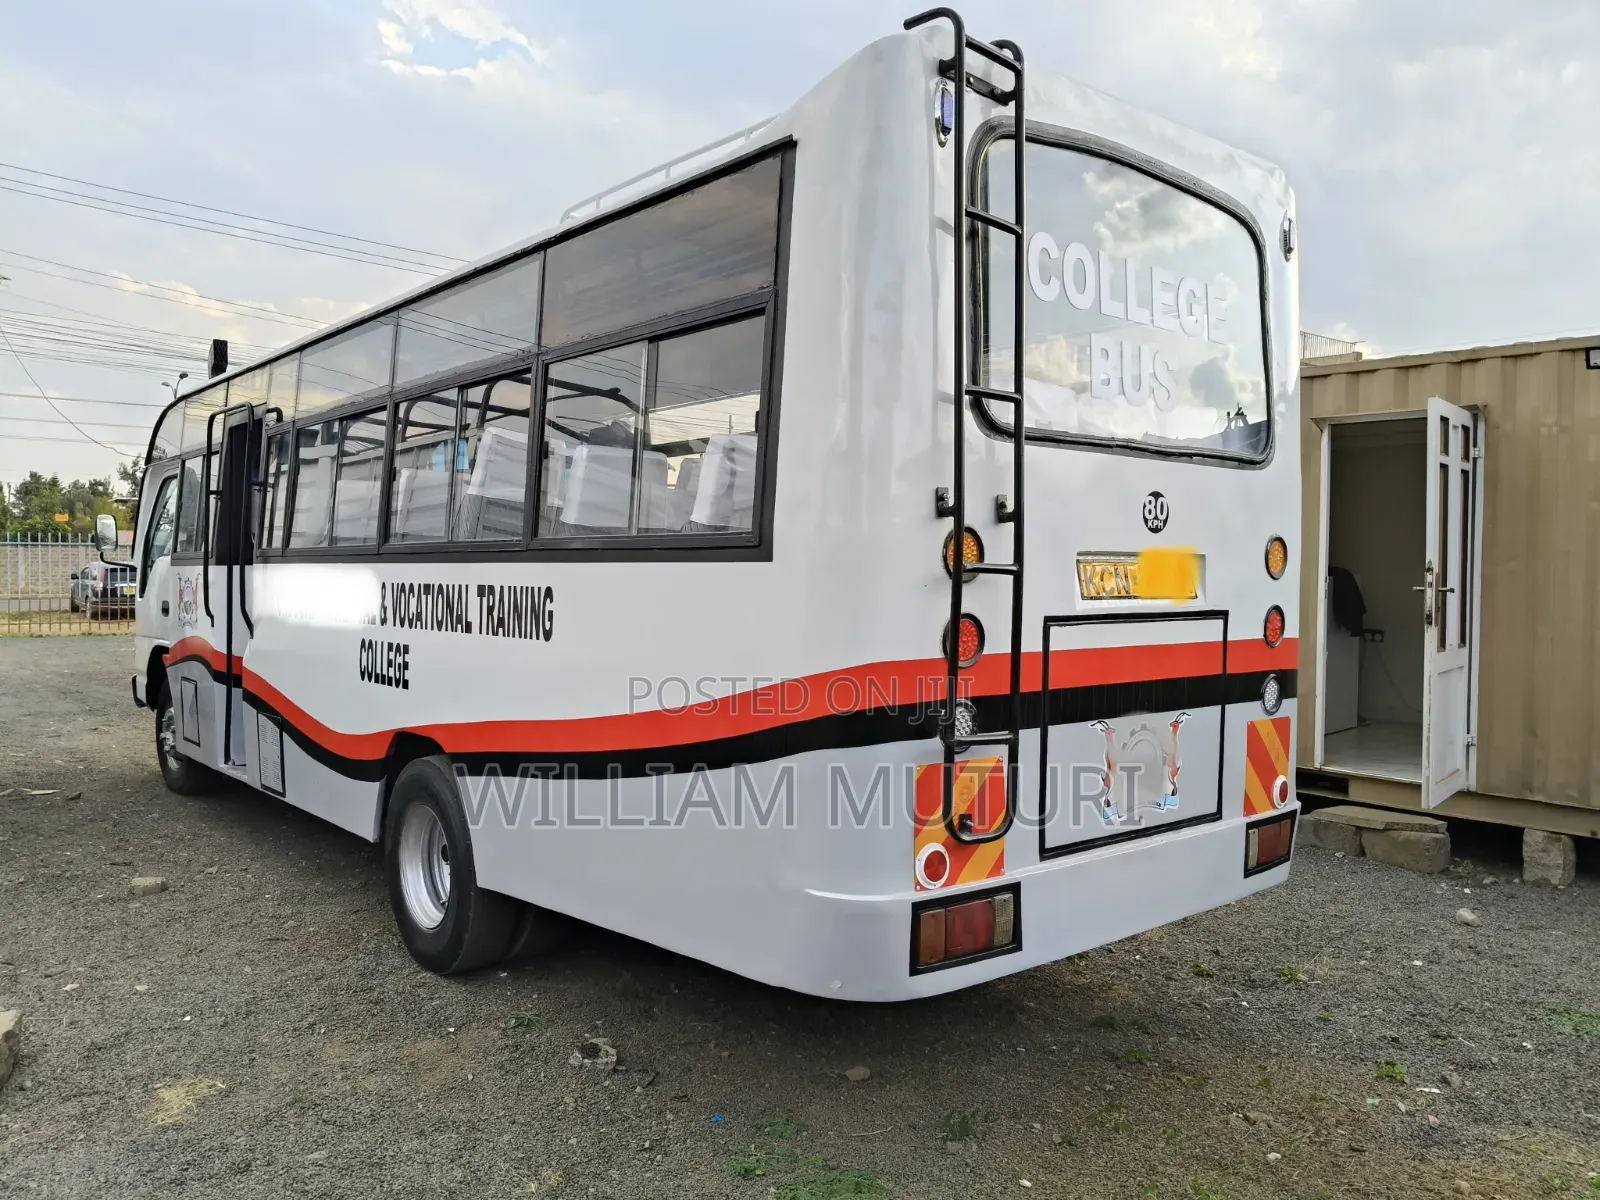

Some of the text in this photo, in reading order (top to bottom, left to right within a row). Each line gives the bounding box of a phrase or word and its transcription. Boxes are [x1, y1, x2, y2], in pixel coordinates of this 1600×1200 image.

[1028, 231, 1228, 345] COLLEGE
[1090, 333, 1180, 413] BUS
[1144, 495, 1168, 520] 80
[1147, 519, 1164, 529] KPH
[380, 582, 388, 626] &
[391, 582, 472, 634] VOCATIONAL
[477, 584, 554, 642] TRAINING
[359, 638, 410, 690] COLLEGE
